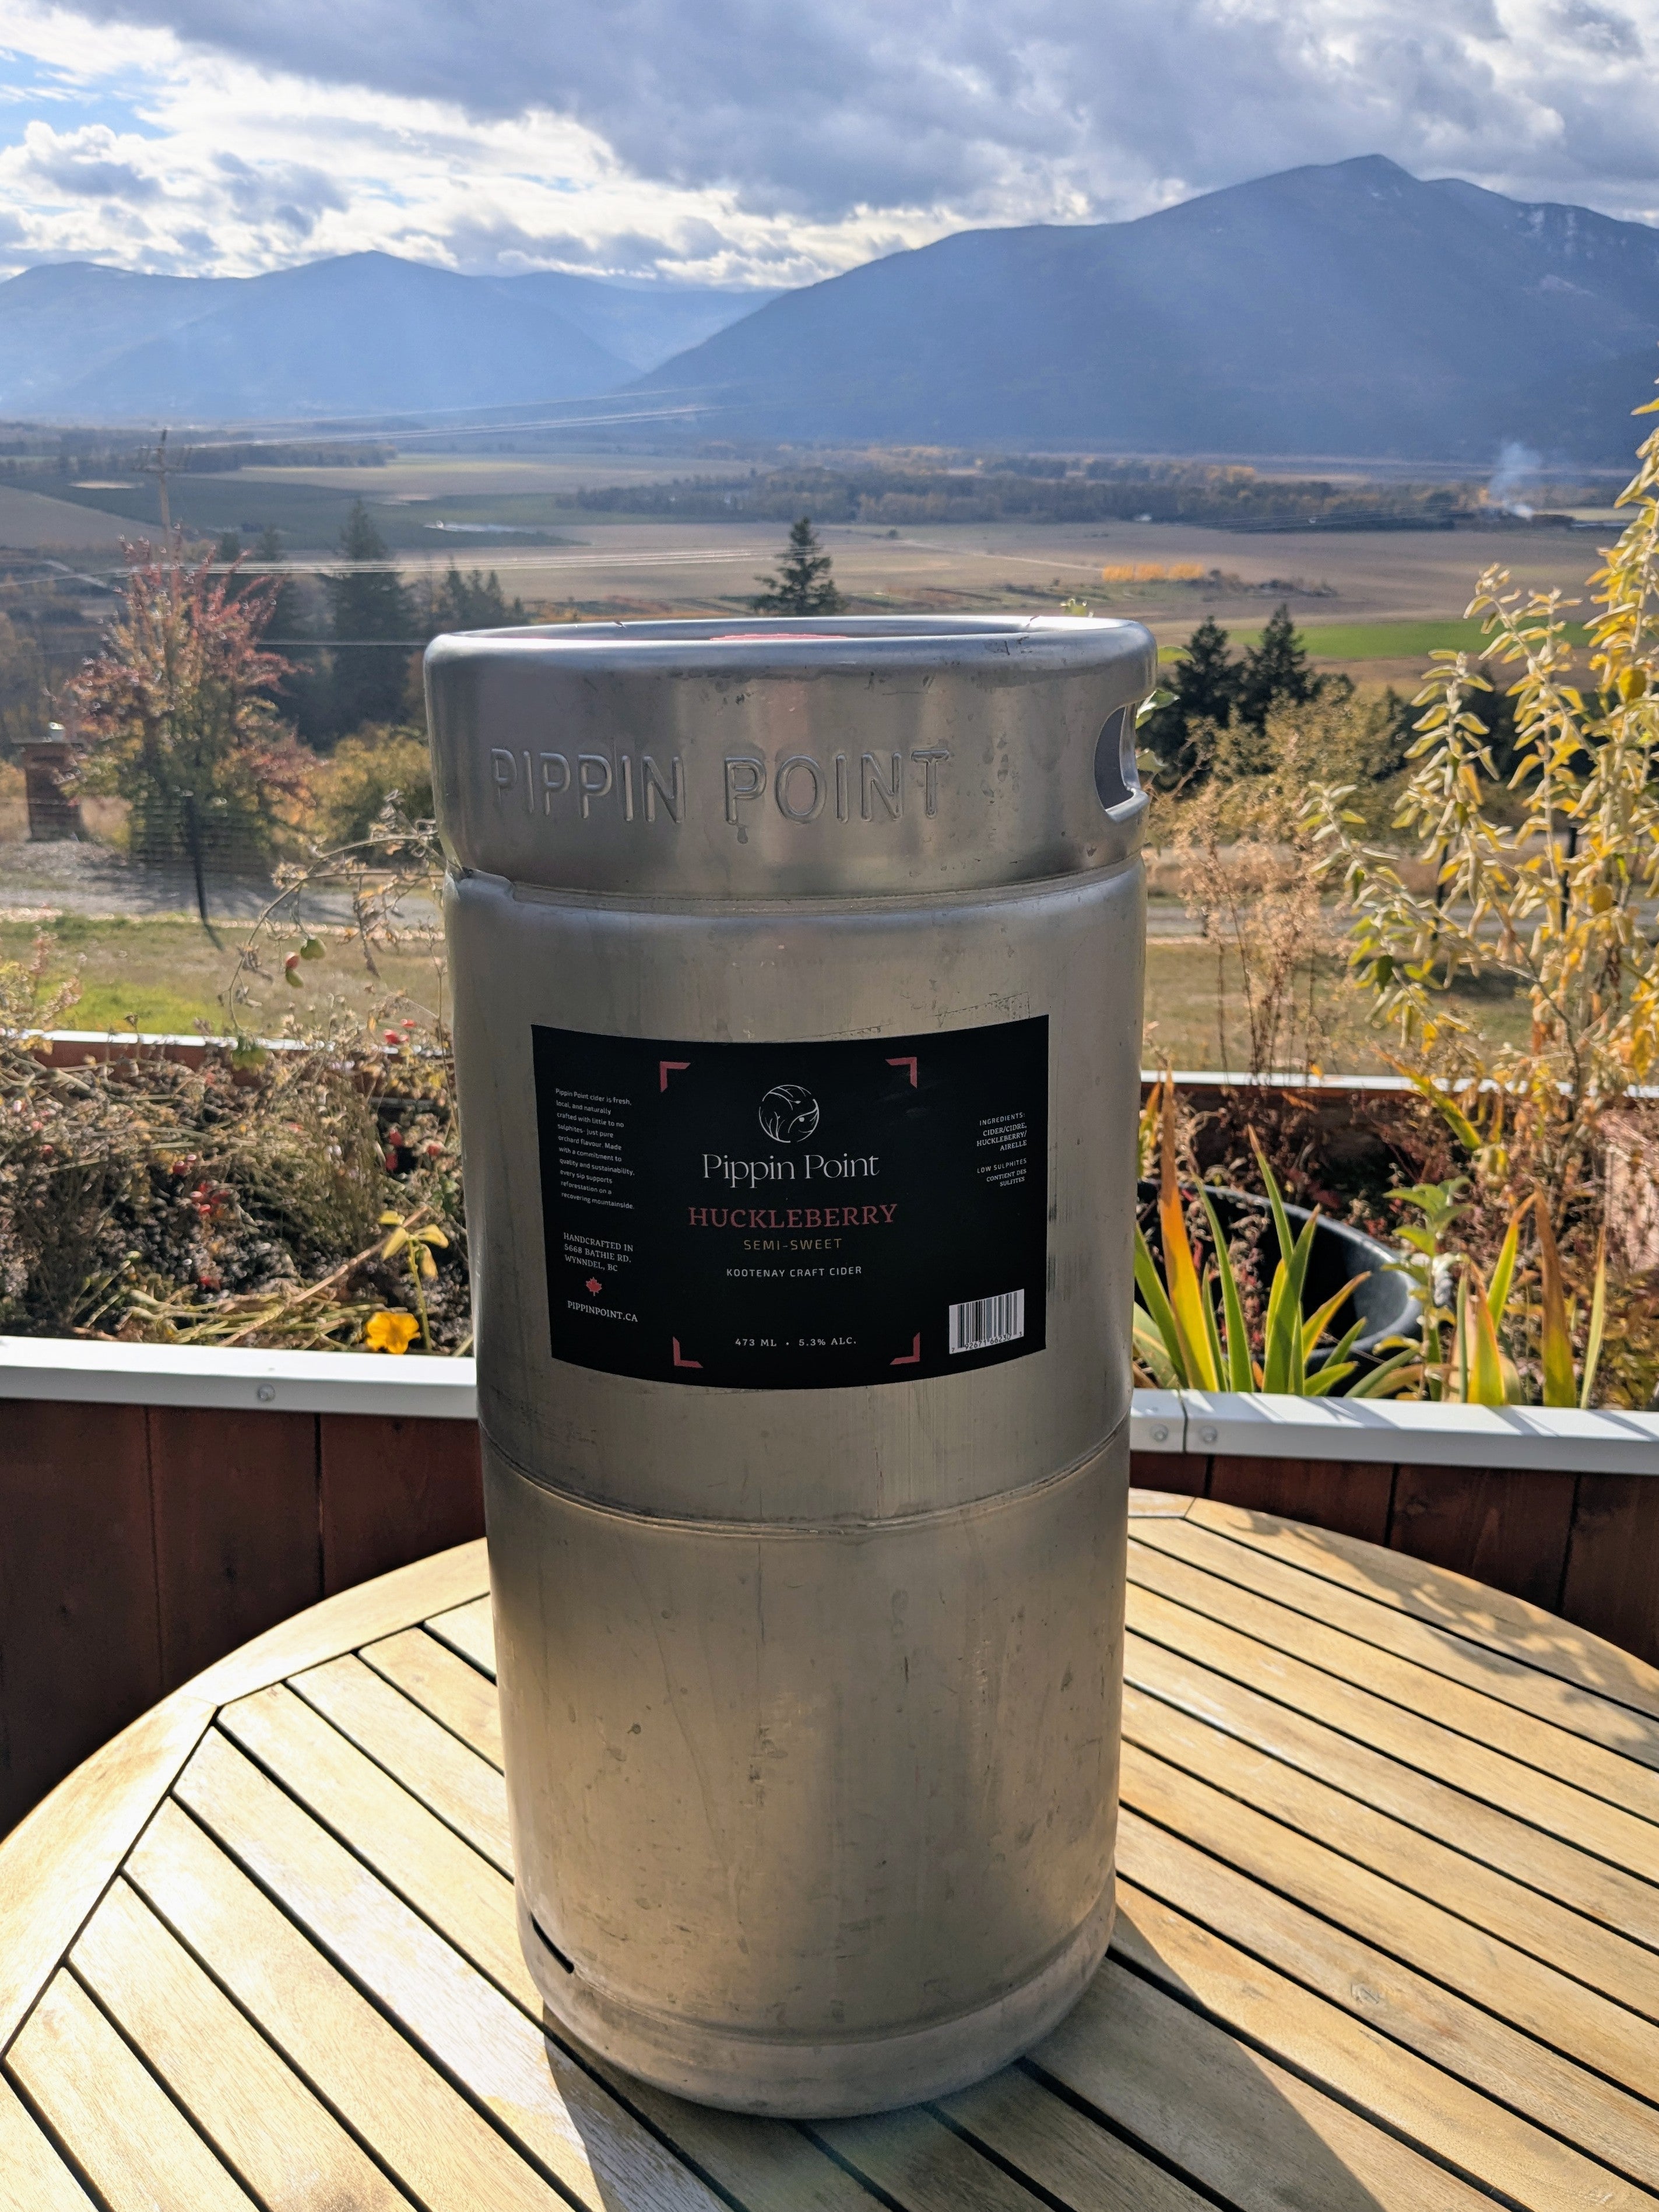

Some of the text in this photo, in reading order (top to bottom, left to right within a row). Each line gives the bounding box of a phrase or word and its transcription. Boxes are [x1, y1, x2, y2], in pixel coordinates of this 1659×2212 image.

[491, 747, 951, 824] PIPPIN POINT
[556, 1088, 572, 1097] Pippin
[574, 1091, 589, 1100] Point
[613, 1097, 632, 1105] fresh,
[557, 1112, 577, 1121] crafted
[584, 1106, 611, 1115] naturally
[979, 1112, 1026, 1126] INGREDIENTS:
[983, 1122, 1028, 1136] CIDER/CIDRE,
[558, 1135, 622, 1151] orchard flavour. Made
[976, 1130, 1028, 1147] HUCKLEBERRY/
[1000, 1140, 1028, 1151] AIRELLE
[560, 1158, 578, 1168] quality
[577, 1151, 614, 1161] commitment
[702, 1153, 880, 1188] Pippin Point
[977, 1158, 1028, 1174] LOW SULPHITES
[560, 1170, 575, 1178] every
[586, 1175, 613, 1184] supports
[986, 1171, 1015, 1182] CONTIENT
[1000, 1176, 1025, 1187] SULFITES
[560, 1181, 598, 1193] reforestation
[561, 1192, 635, 1209] recovering mountainside.
[687, 1204, 898, 1228] HUCKLEBERRY
[563, 1232, 634, 1252] HANDCRAFTED IN
[743, 1238, 843, 1251] SEMI-SWEET
[564, 1244, 631, 1263] 5668 BATHIE RD.
[564, 1254, 605, 1270] WYNNDEL,
[726, 1266, 862, 1278] KOOTENAY CRAFT CIDER
[567, 1300, 638, 1322] PIPPINPOINT.CA
[734, 1336, 857, 1347] 473 ML 5.3% ALC.
